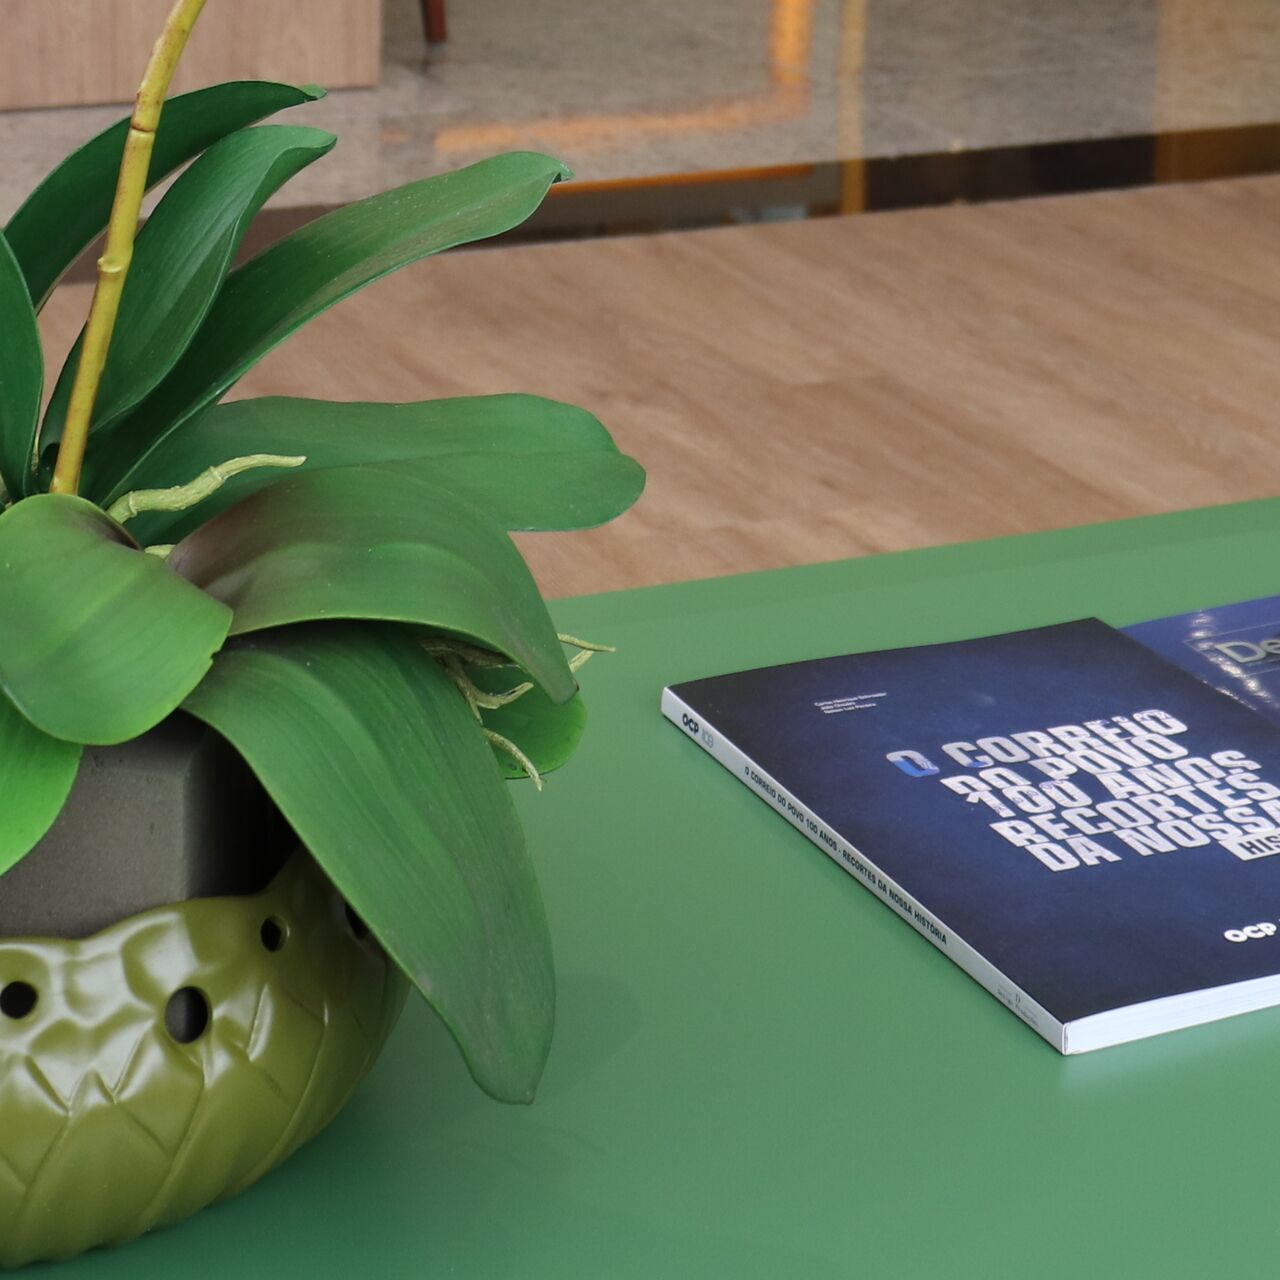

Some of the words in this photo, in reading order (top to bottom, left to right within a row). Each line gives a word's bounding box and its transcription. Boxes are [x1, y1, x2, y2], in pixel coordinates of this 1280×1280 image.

[682, 713, 700, 735] OCP
[886, 750, 940, 777] O
[941, 709, 1188, 767] CORREIO
[940, 768, 1031, 795] DO
[1029, 733, 1188, 780] POVO
[966, 780, 1093, 818] 100
[1096, 750, 1261, 799] ANOS
[751, 771, 777, 799] CORREIO
[777, 794, 786, 807] DO
[788, 803, 805, 823] POVO
[806, 818, 818, 834] 100
[819, 830, 838, 851] ANOS
[842, 849, 877, 885] RECORTES
[877, 876, 888, 893] DA
[889, 890, 913, 914] NOSSA
[914, 910, 947, 945] HISTÓRIA
[1024, 836, 1122, 871] DA
[1224, 922, 1277, 942] OCP
